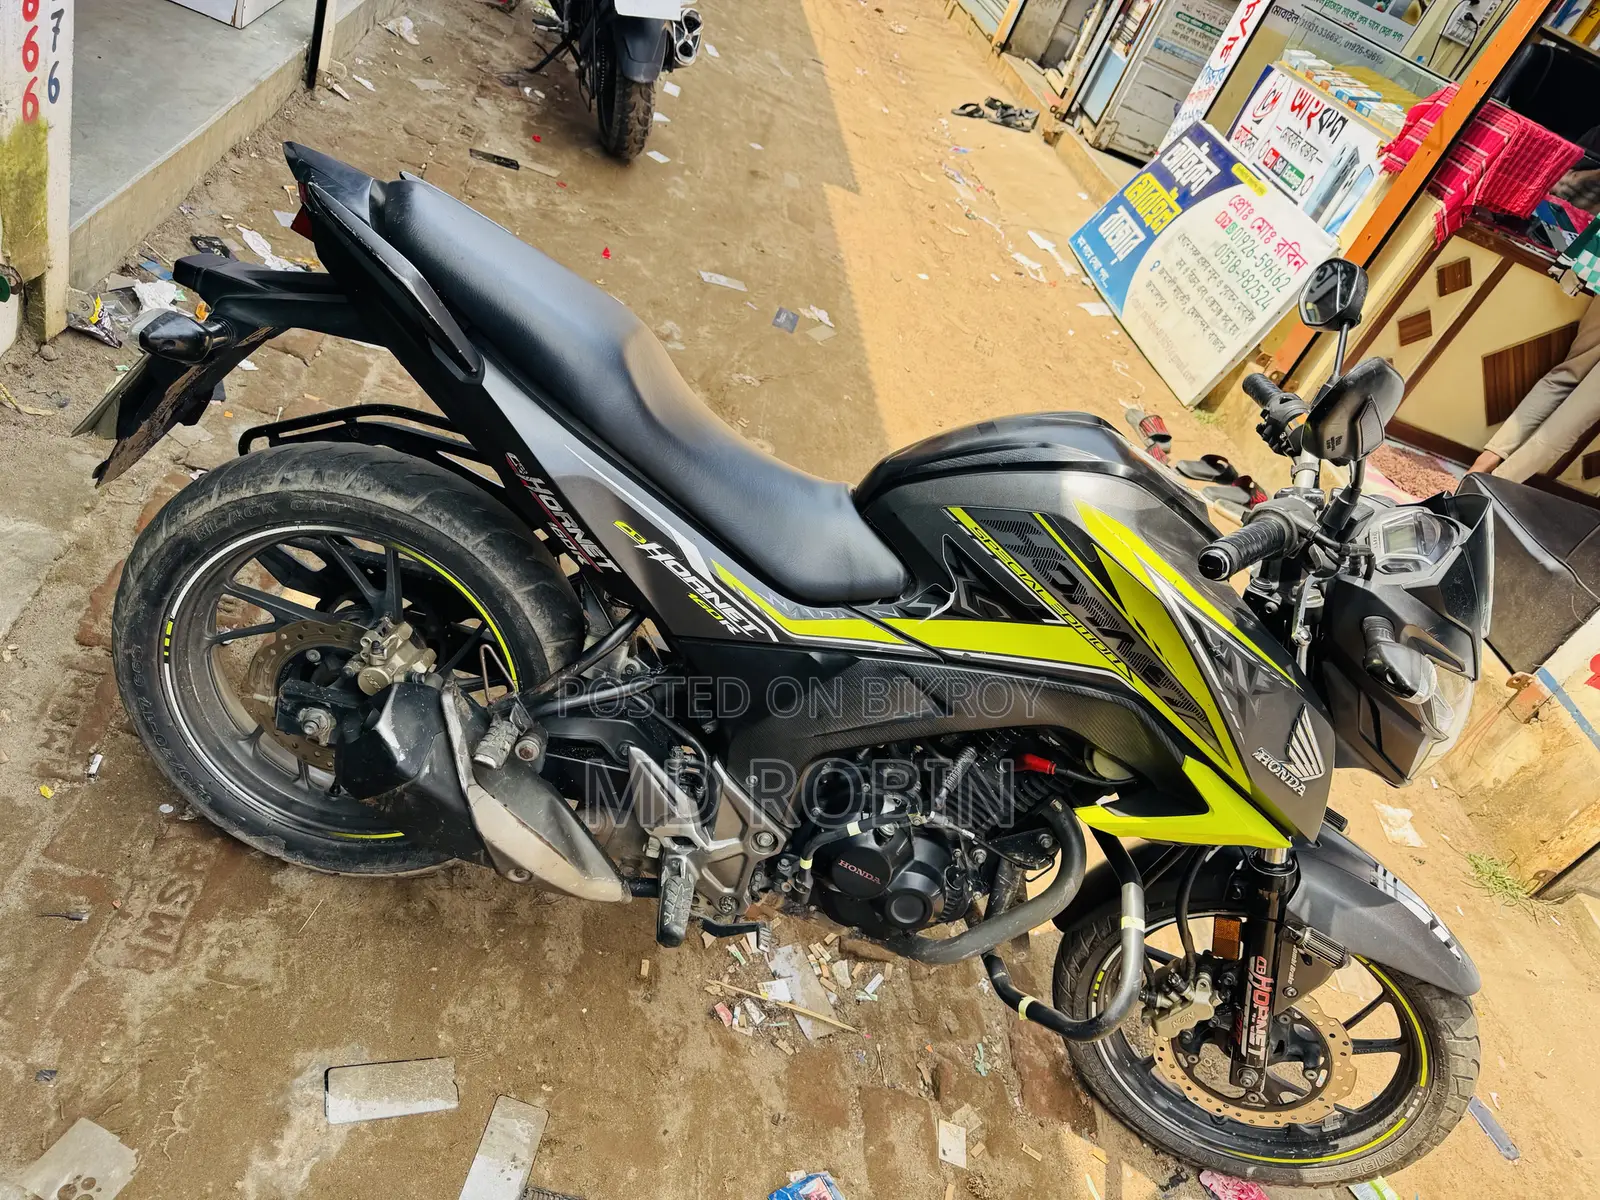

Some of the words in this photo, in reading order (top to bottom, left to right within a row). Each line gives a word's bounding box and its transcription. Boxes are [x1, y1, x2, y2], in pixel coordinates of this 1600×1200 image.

[1160, 135, 1222, 197] আইকন
[1123, 171, 1184, 235] মোবাইল
[1097, 205, 1147, 266] বাজার
[1230, 226, 1293, 294] 01926-596162
[1250, 216, 1278, 245] মোঃ
[1273, 235, 1308, 275] রবিন
[1214, 242, 1272, 312] 01518-982524
[521, 475, 621, 574] HORNET
[636, 541, 766, 637] HORNET
[687, 592, 742, 636] 160R
[969, 526, 1048, 602] SPECIAL
[1049, 602, 1122, 667] EDITION
[1251, 746, 1308, 797] HONDA
[837, 859, 882, 885] HONDA
[1248, 971, 1275, 1061] HORNET
